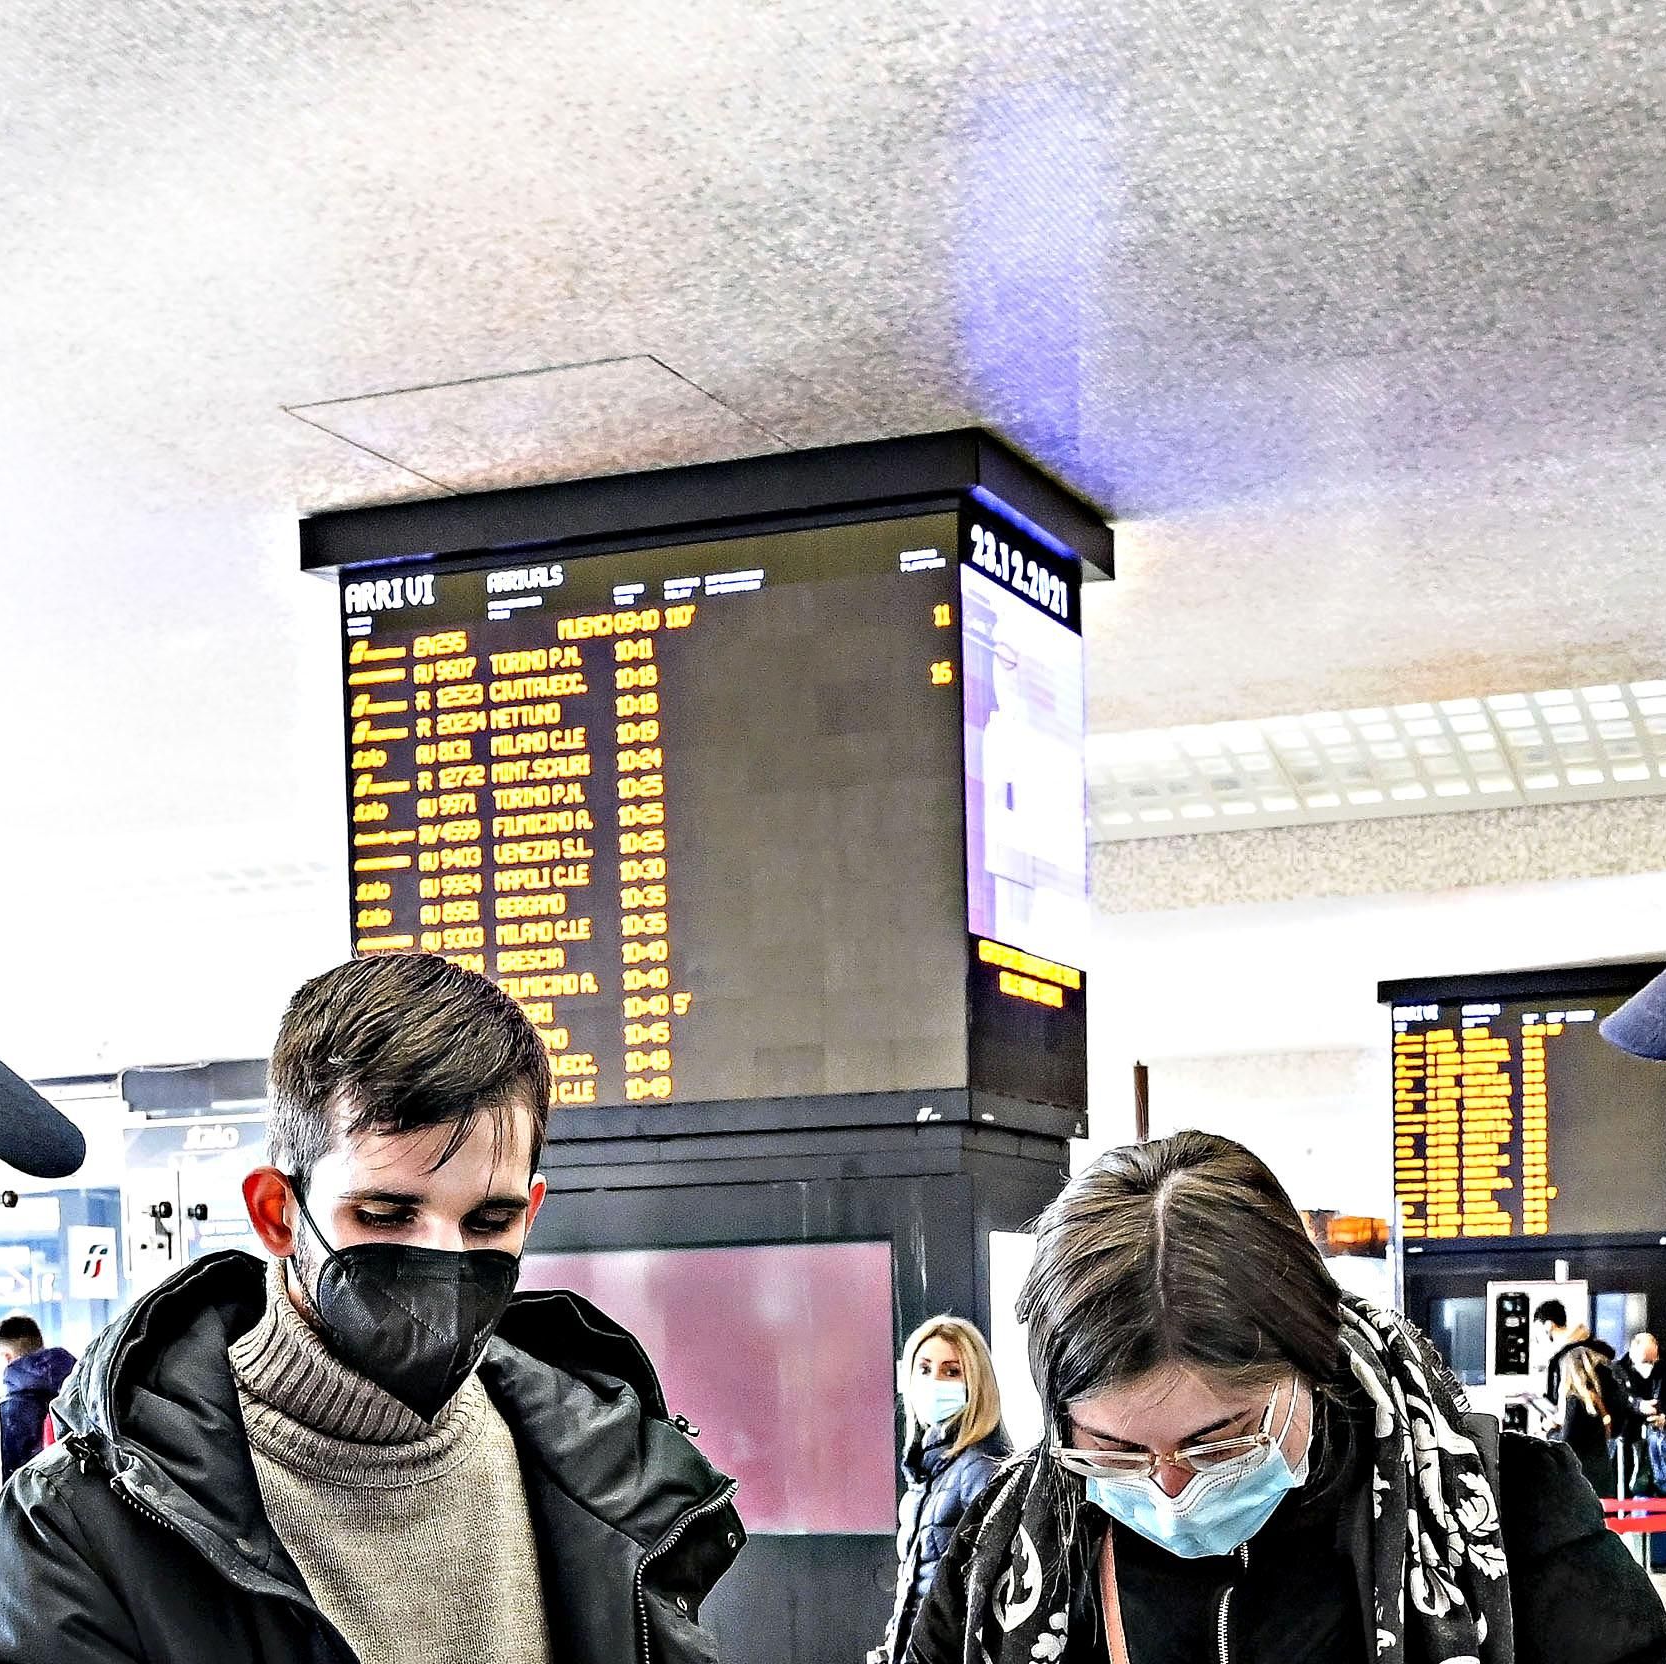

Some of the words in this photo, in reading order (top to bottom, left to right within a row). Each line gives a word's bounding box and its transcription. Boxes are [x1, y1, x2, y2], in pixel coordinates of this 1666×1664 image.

[971, 524, 1068, 619] 23.12.2021
[345, 574, 435, 613] ARRIVI
[486, 564, 564, 594] ARRIVALS
[933, 604, 951, 627] 11
[489, 648, 548, 675] TORINO
[414, 690, 431, 711] R
[416, 717, 432, 738] R
[490, 702, 561, 730] NETTUNO
[490, 731, 548, 757] MILANO
[417, 771, 433, 792] R
[492, 785, 551, 810] TORINO
[492, 810, 574, 838] FIUMICINO
[493, 839, 561, 865] VENEZIA
[494, 866, 551, 892] NAPOLI
[495, 892, 566, 919] BERGAMO
[495, 920, 554, 946] MILANO
[496, 947, 565, 973] BRESCIA
